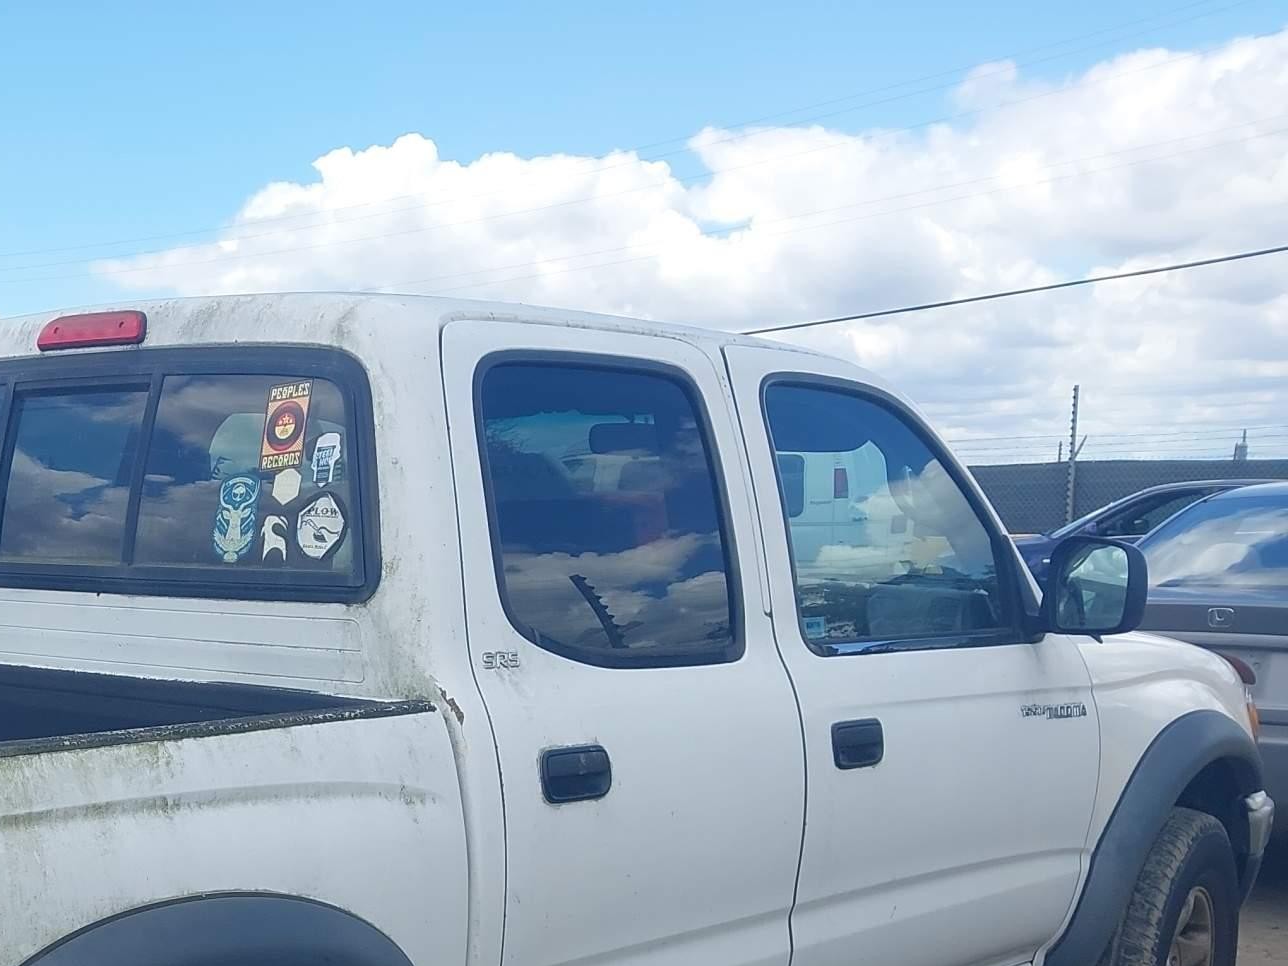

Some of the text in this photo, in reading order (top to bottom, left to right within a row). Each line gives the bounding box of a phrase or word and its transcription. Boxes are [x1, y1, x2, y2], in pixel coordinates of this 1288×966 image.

[271, 383, 310, 400] PEOPLES
[262, 452, 300, 469] RECORDS
[306, 506, 339, 517] PLOW
